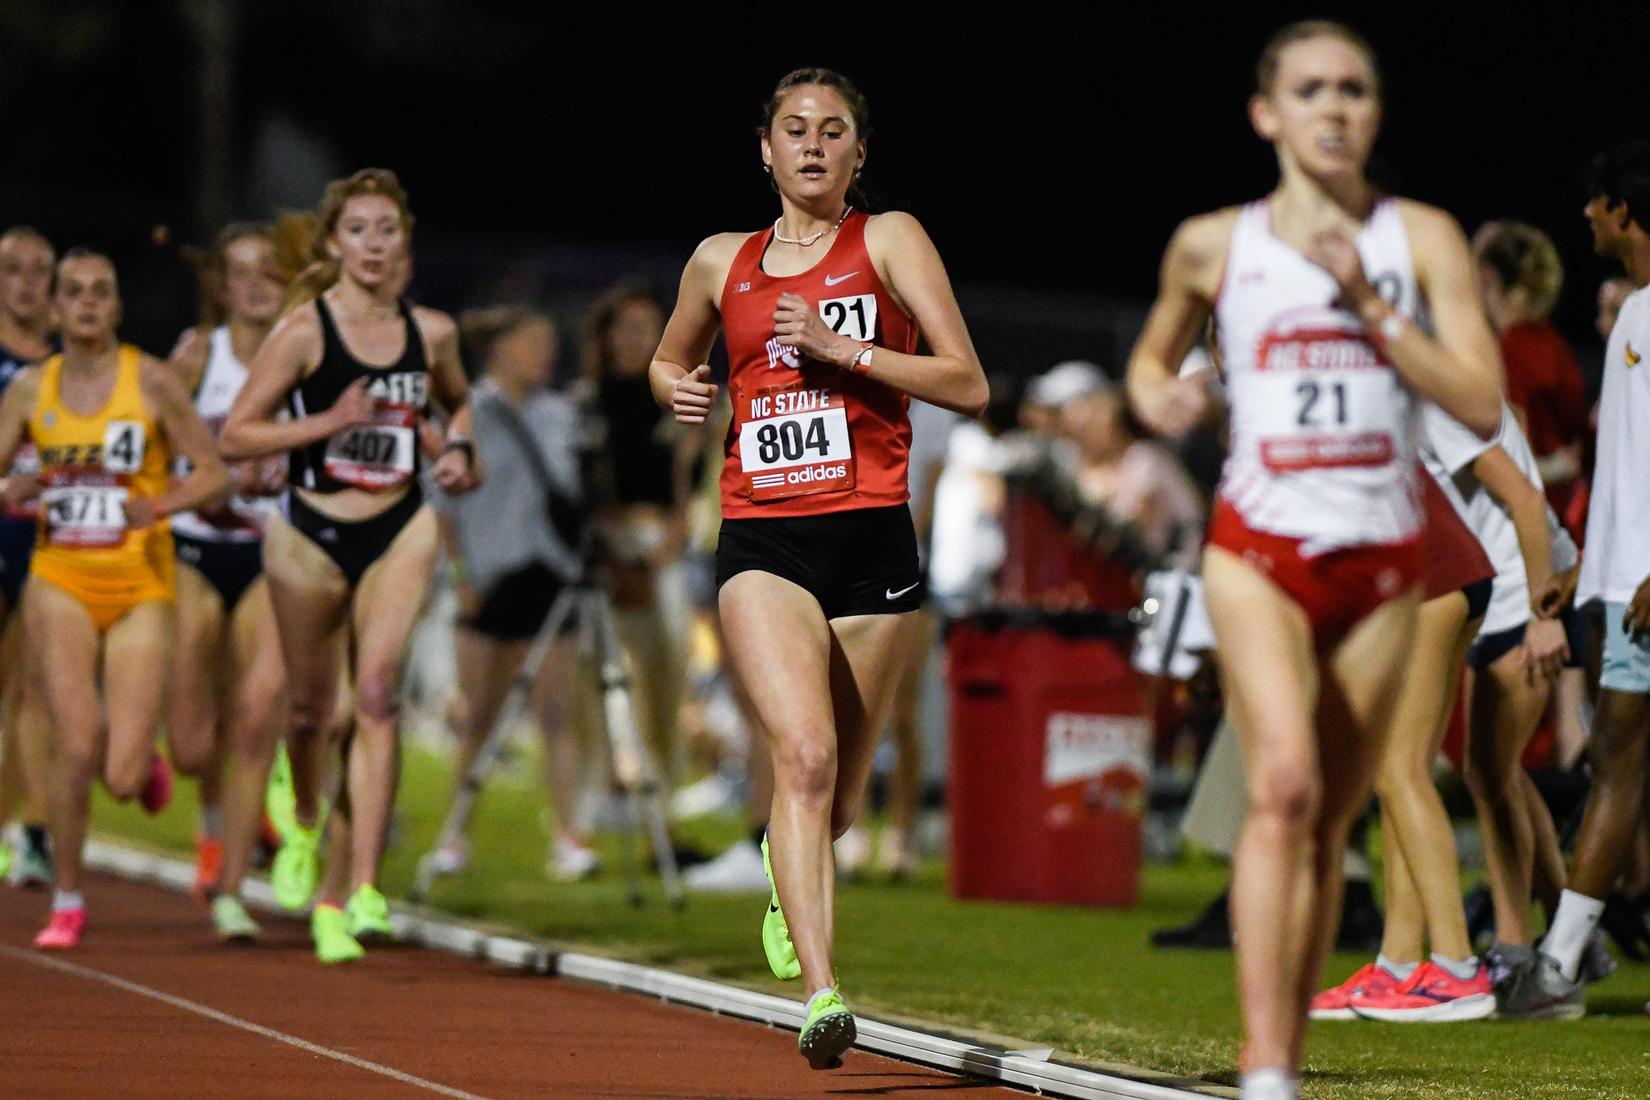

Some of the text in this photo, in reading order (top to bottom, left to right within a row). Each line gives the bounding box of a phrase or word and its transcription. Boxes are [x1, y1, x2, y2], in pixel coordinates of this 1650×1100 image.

[824, 298, 867, 339] 21
[751, 396, 772, 419] NC
[774, 388, 830, 415] STATE
[1295, 381, 1347, 425] 21
[110, 425, 135, 466] 4
[343, 430, 397, 463] 407
[757, 416, 830, 464] 804
[787, 464, 847, 485] adidas
